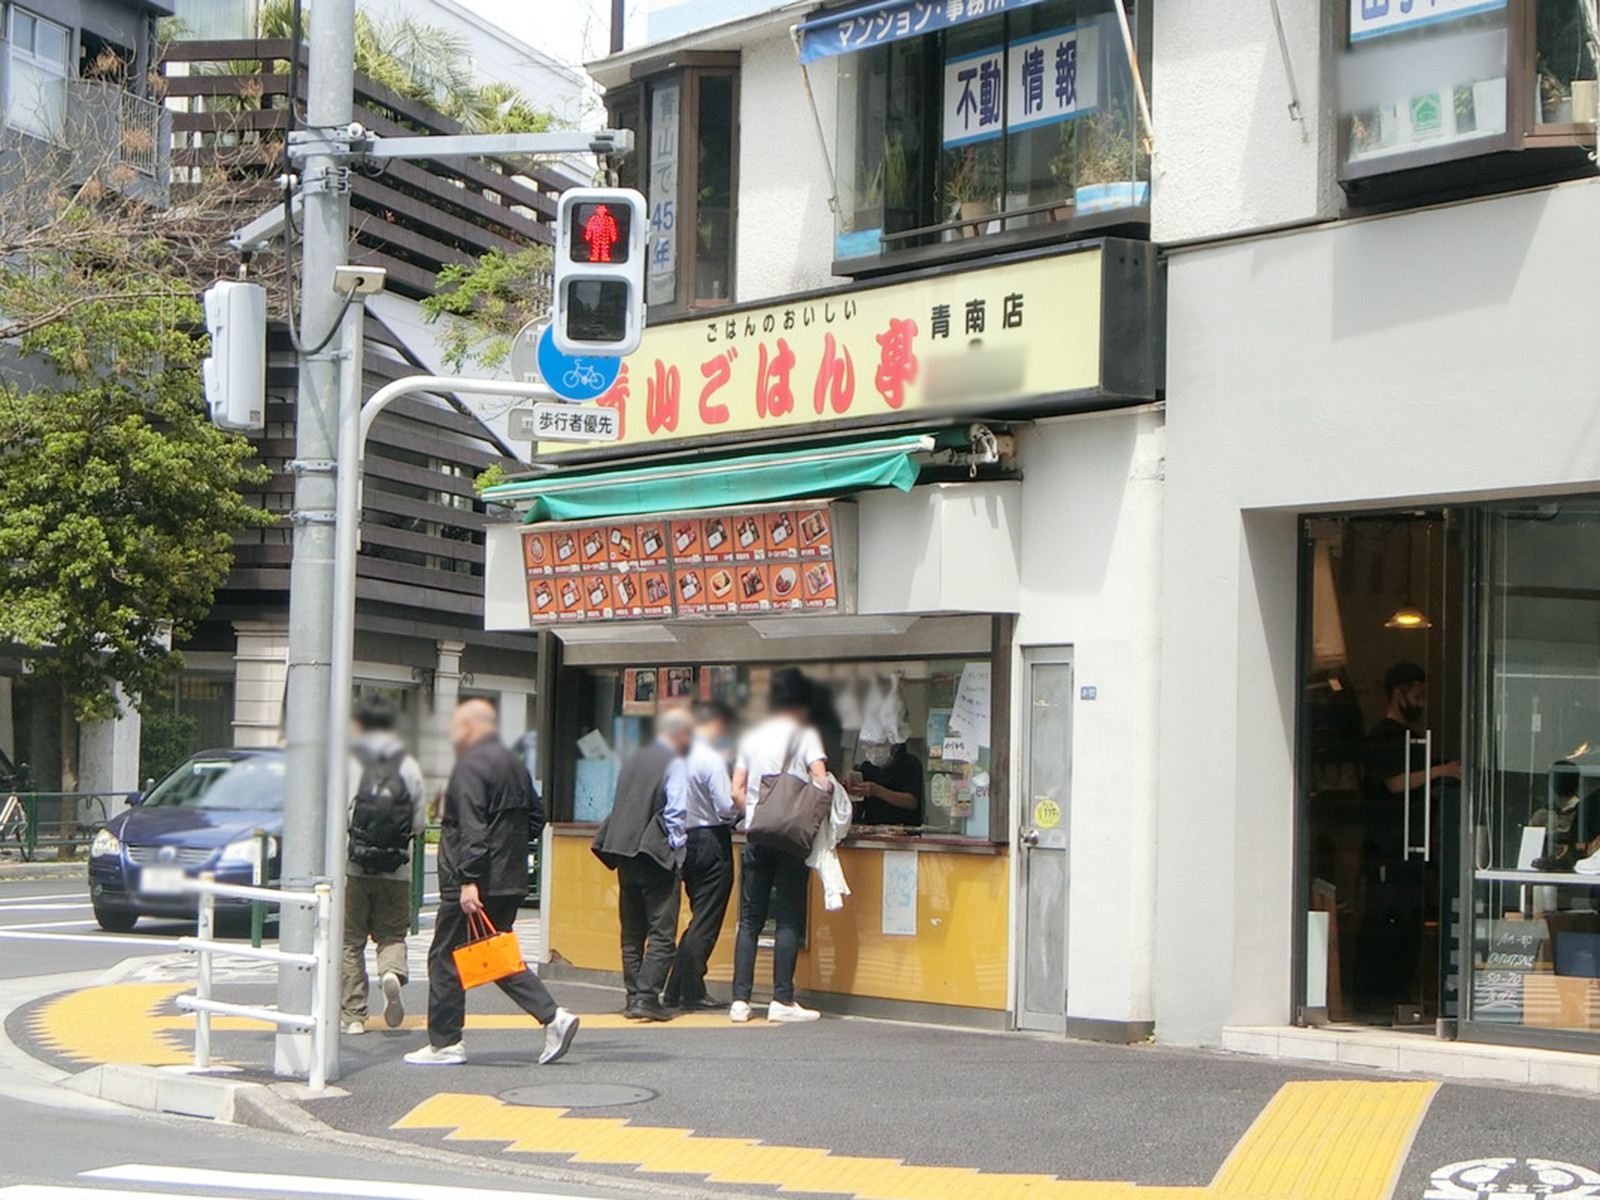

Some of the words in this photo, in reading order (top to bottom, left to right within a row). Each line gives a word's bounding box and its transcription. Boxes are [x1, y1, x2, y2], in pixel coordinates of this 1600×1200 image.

[652, 92, 675, 269] 青山で45年
[706, 299, 857, 343] ごはんのおいしい
[930, 292, 1025, 340] 青南店
[539, 411, 612, 435] 歩行者優先
